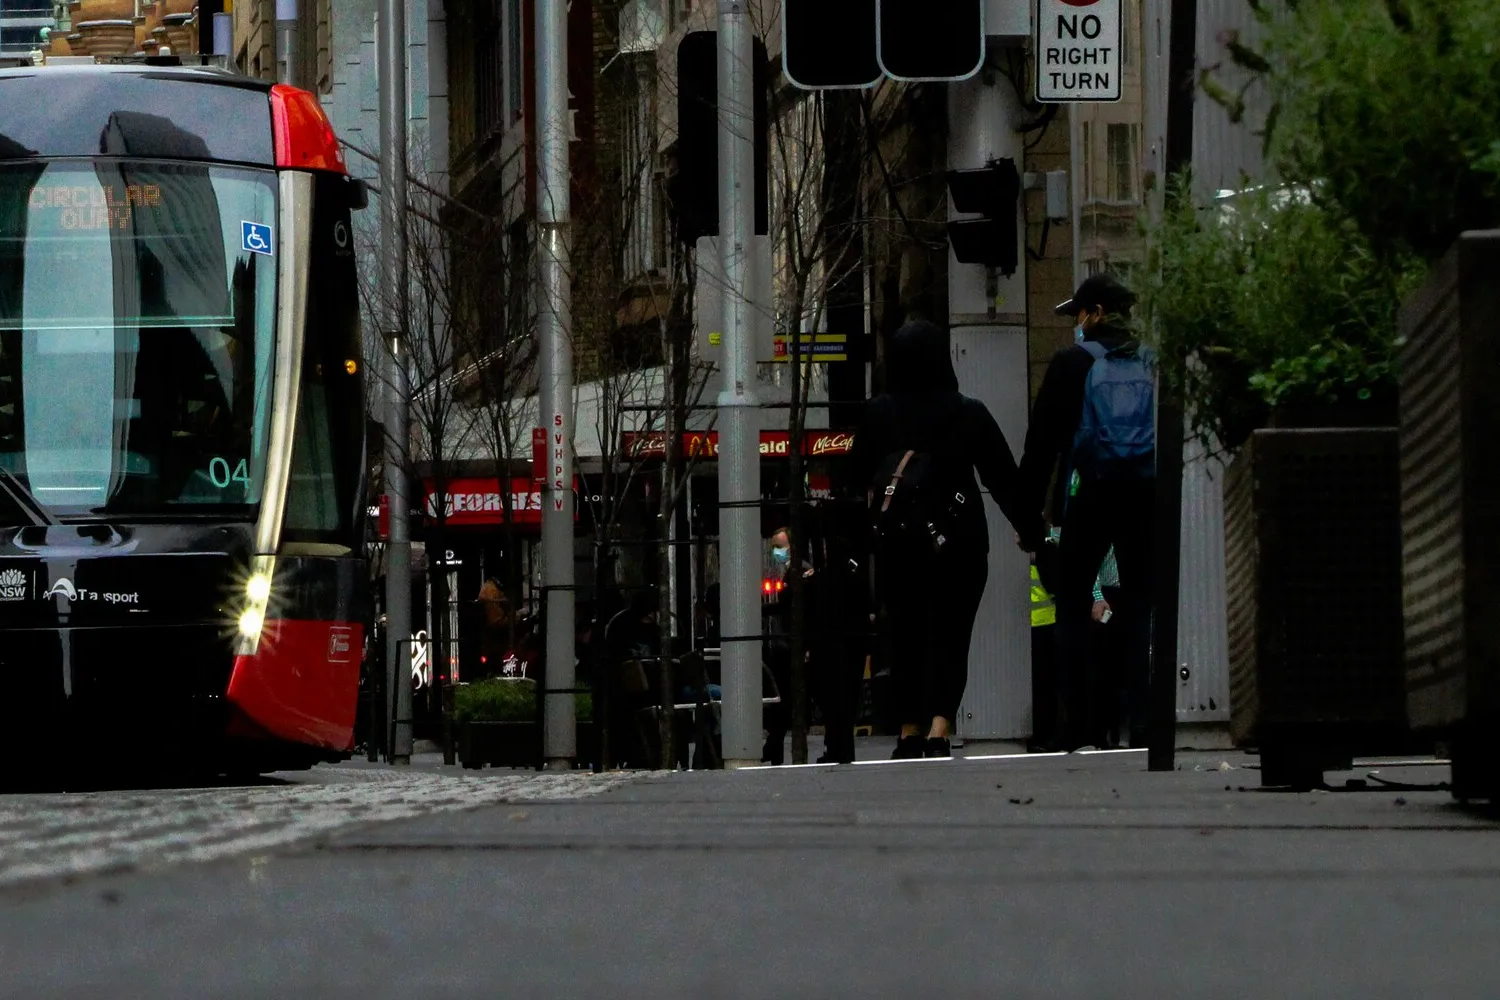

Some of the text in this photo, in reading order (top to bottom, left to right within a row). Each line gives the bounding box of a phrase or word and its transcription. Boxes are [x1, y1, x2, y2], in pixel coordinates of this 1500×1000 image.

[1057, 14, 1101, 40] NO
[1047, 47, 1111, 65] RIGHT
[1049, 72, 1109, 89] TURN
[29, 184, 161, 208] CIRCULAR
[61, 206, 131, 230] QUAY
[209, 456, 252, 488] 04
[78, 588, 139, 605] Tasport
